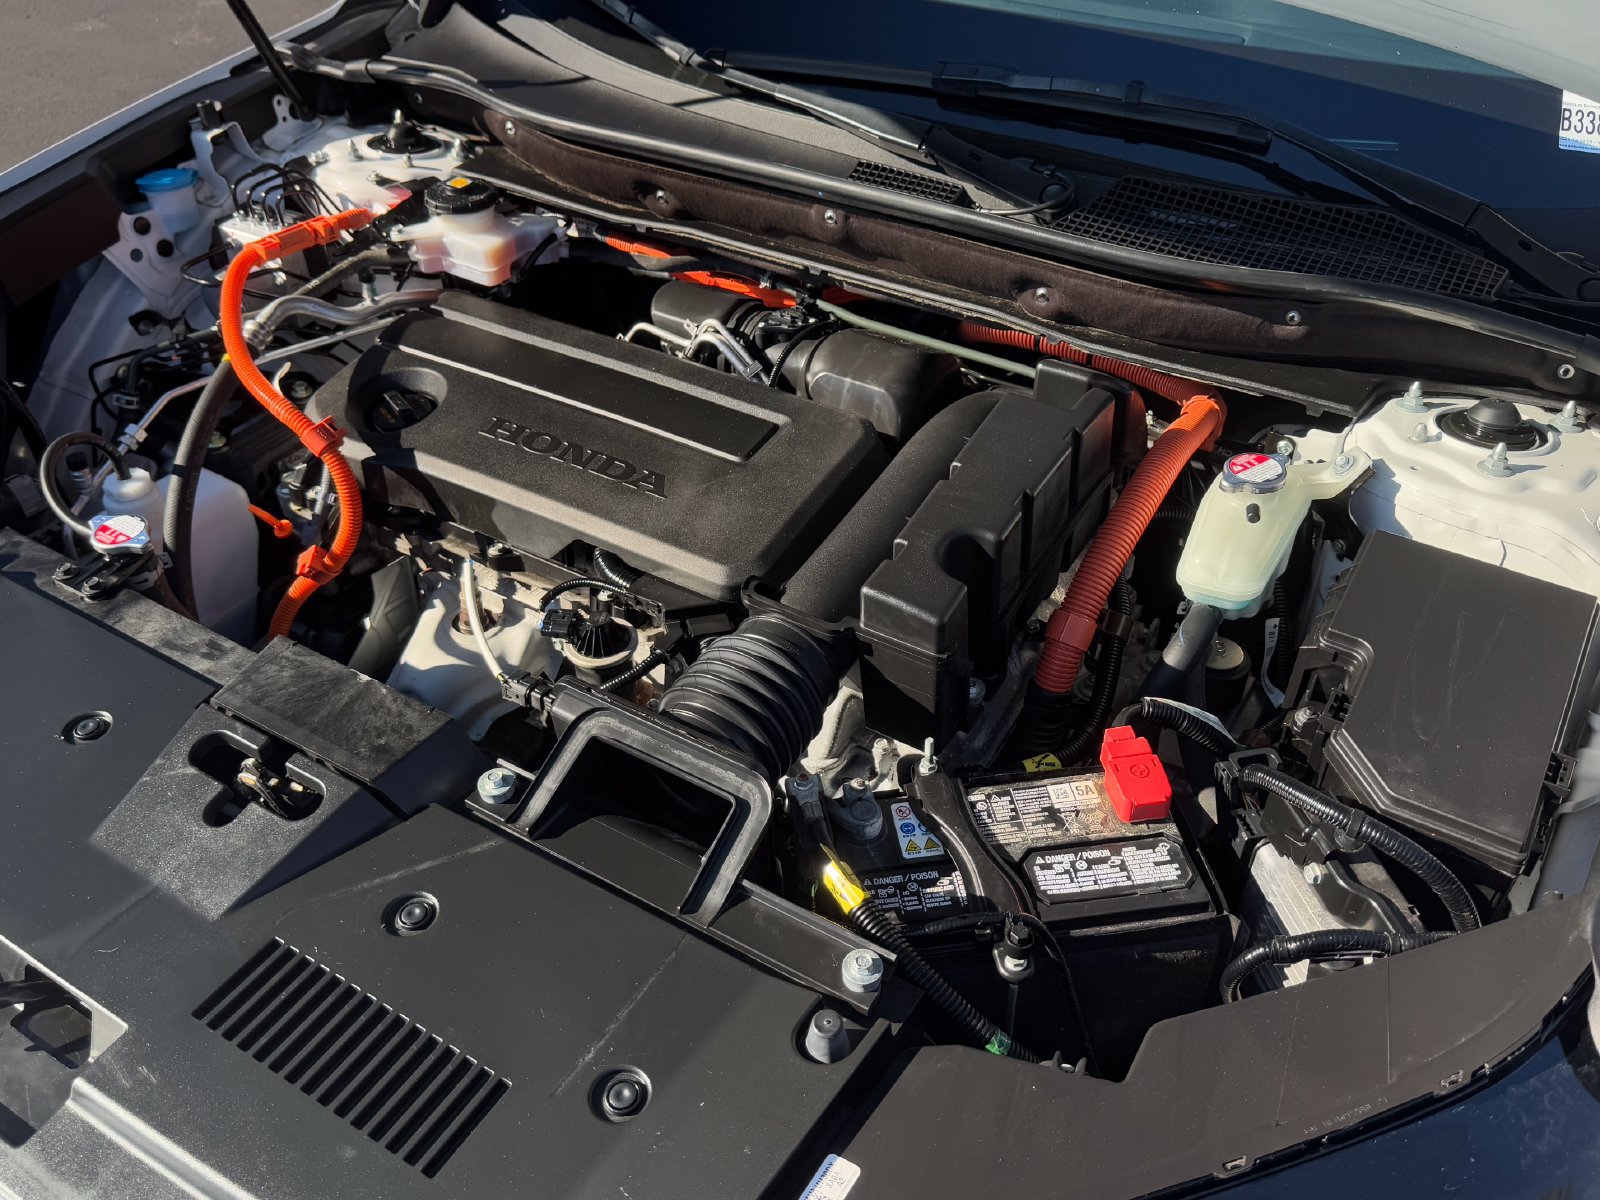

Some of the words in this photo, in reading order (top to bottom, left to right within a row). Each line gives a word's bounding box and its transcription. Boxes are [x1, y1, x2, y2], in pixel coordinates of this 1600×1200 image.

[478, 416, 668, 500] HONDA
[1075, 784, 1095, 796] 5A
[1045, 853, 1076, 864] DANGER
[1082, 849, 1111, 861] POISON
[873, 875, 903, 886] DANGER
[911, 870, 939, 881] POISON
